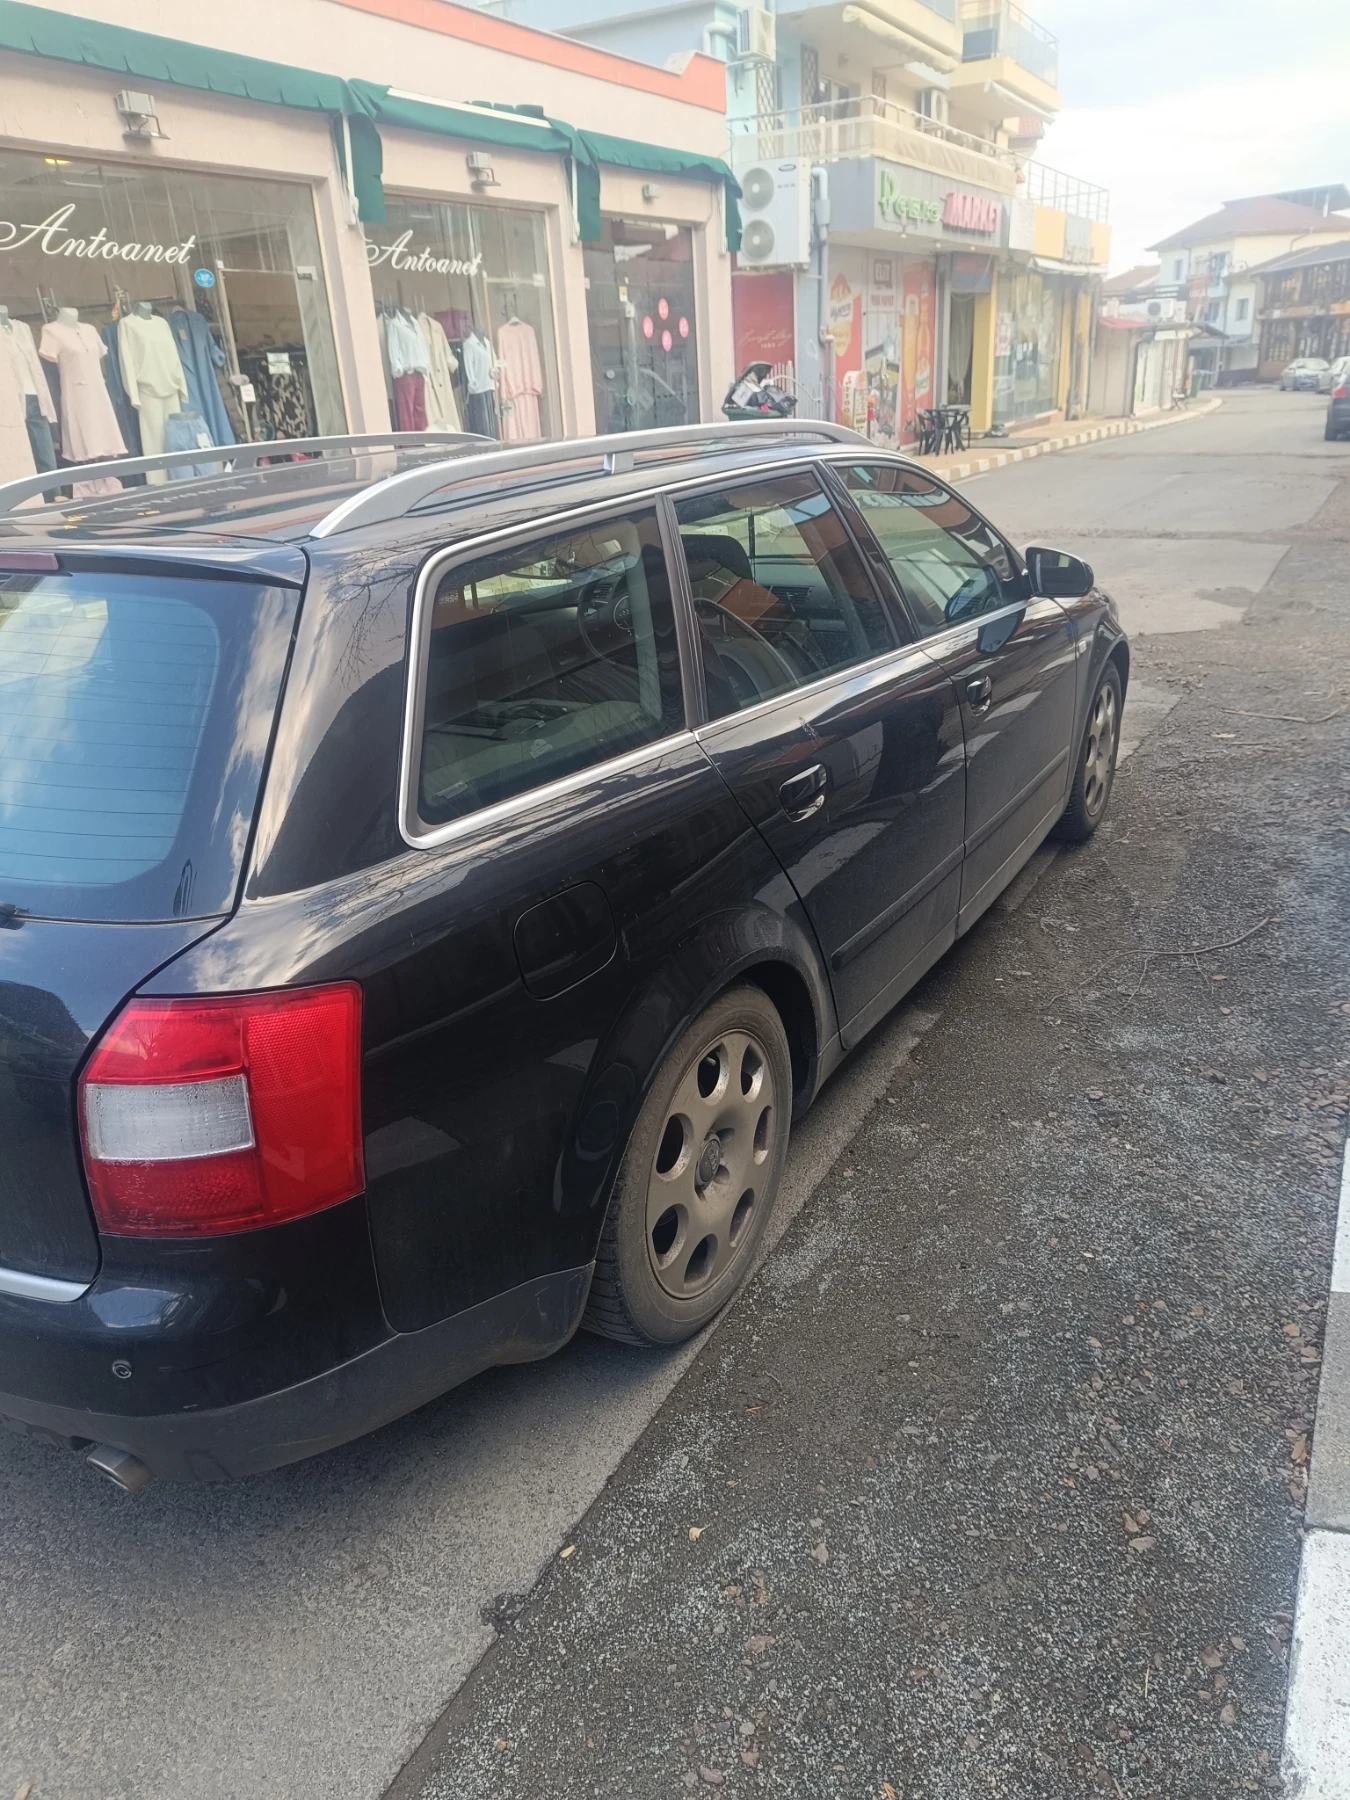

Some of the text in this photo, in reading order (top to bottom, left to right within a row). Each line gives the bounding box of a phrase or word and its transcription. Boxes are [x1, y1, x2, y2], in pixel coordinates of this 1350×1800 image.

[0, 203, 196, 264] Antoanet
[944, 193, 1001, 232] MARKET
[367, 229, 482, 276] Antoanet
